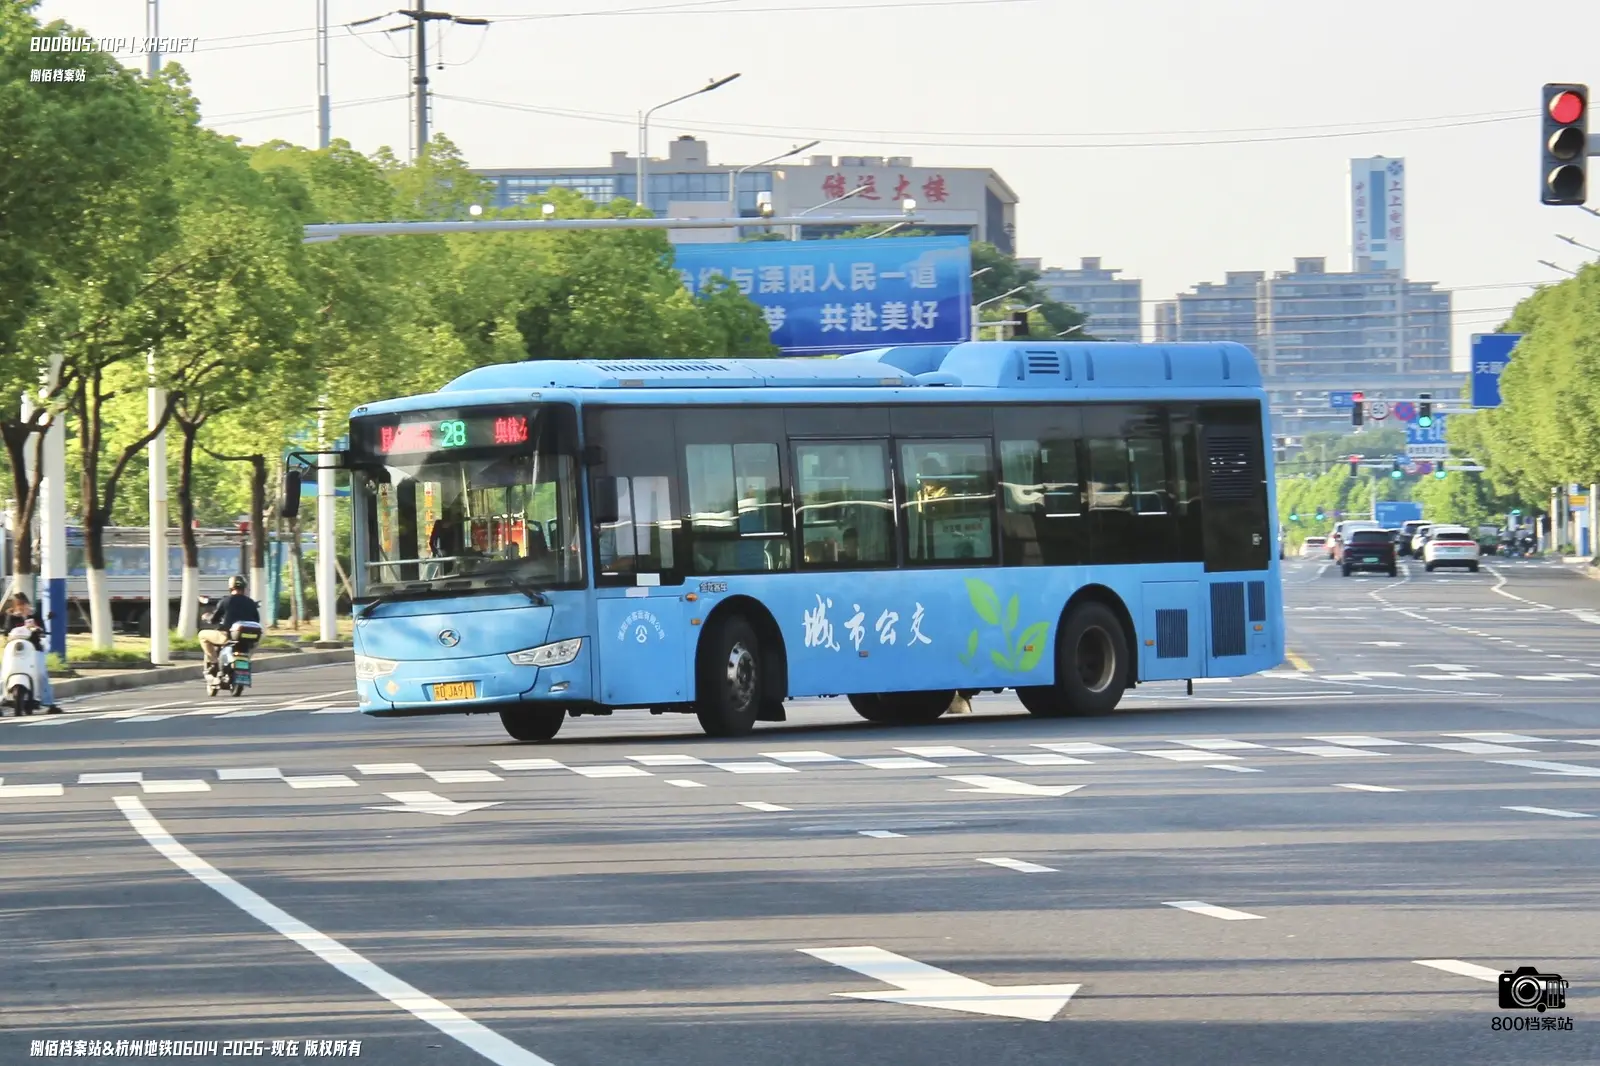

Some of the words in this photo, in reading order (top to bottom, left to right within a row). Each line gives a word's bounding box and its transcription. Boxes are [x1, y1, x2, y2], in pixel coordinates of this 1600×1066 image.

[819, 300, 939, 333] 共赴美好
[439, 420, 467, 448] 28
[801, 593, 933, 653] 城市公交
